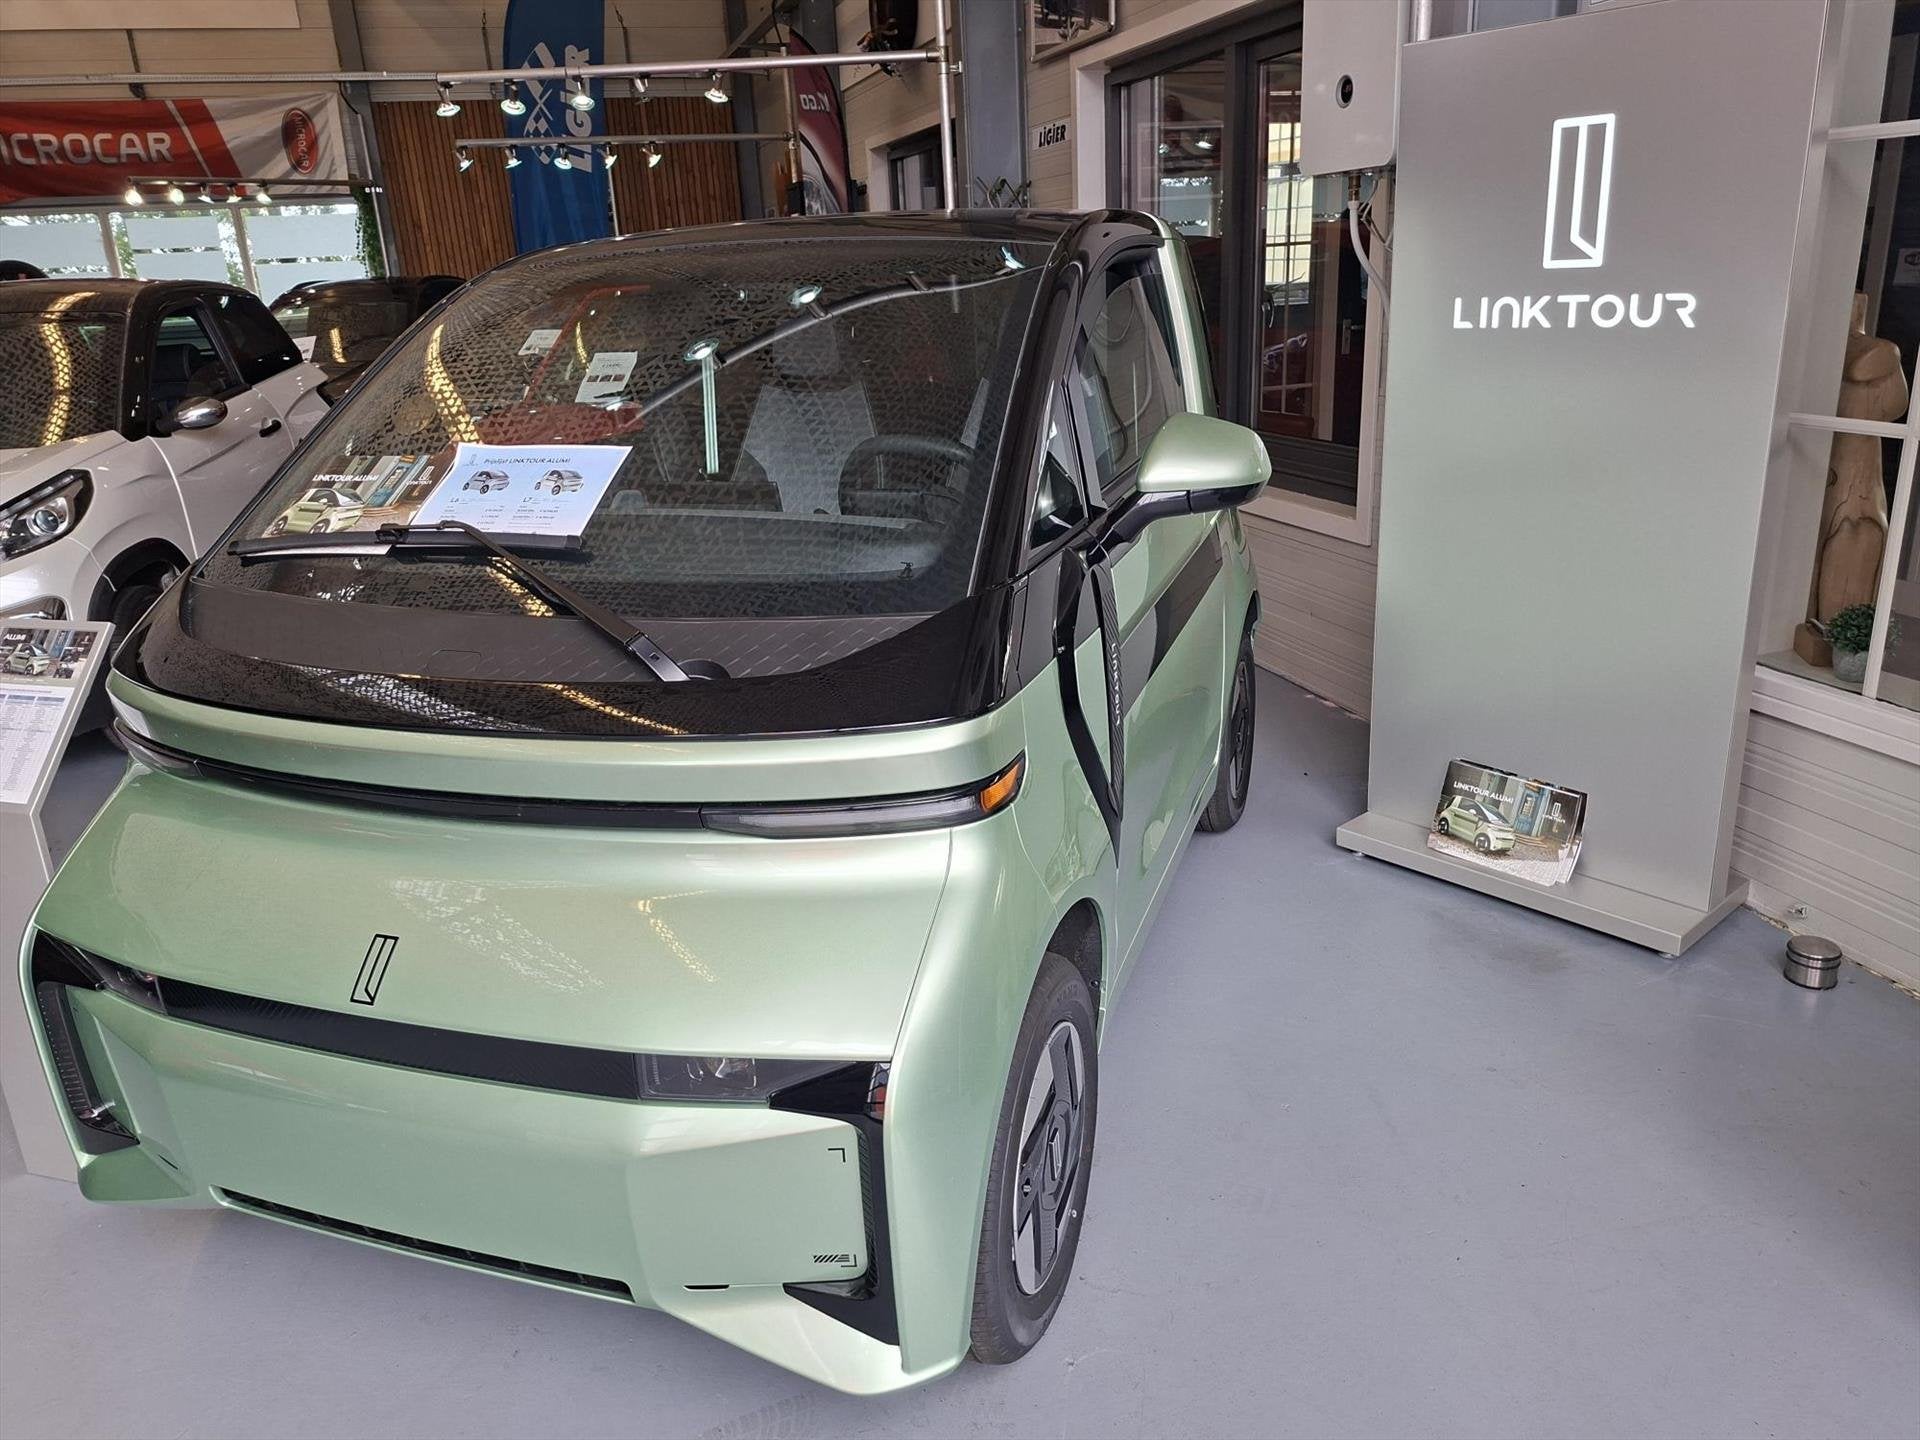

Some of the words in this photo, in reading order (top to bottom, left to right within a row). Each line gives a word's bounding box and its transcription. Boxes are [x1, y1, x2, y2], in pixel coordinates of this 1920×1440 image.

[293, 113, 310, 167] MICROCAR
[1453, 292, 1697, 329] LINKTOUR
[312, 474, 353, 482] LINKTOUR
[1453, 781, 1490, 797] LINKTOUR
[1489, 791, 1514, 804] ALUMI
